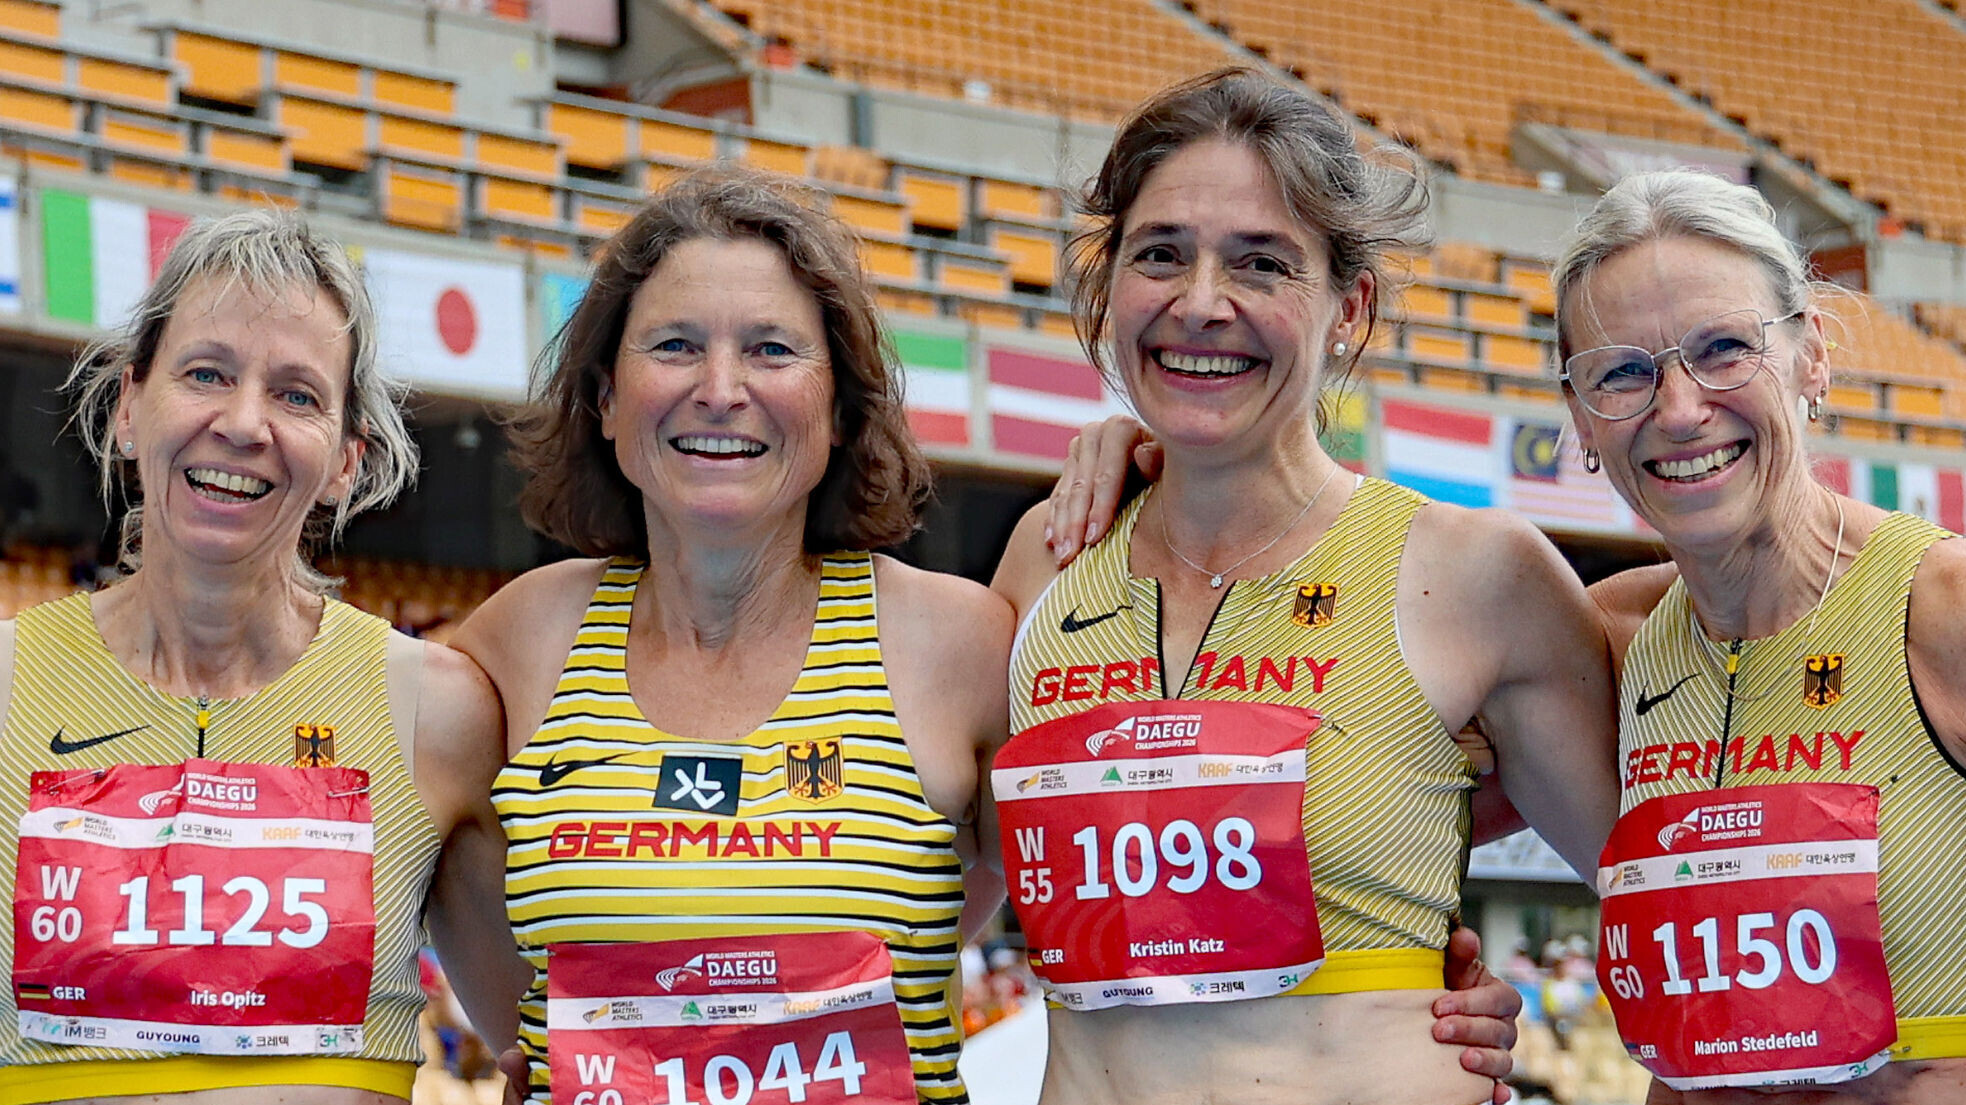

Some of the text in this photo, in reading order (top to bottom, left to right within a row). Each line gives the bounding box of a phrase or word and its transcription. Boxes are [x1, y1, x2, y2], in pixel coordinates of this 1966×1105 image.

[1031, 651, 1340, 707] GERMANY
[1136, 722, 1201, 741] DAEGU
[1625, 731, 1865, 789] GERMANY
[188, 780, 257, 802] DAEGU
[1701, 810, 1762, 831] DAEGU
[547, 822, 843, 859] GERMANY
[1015, 826, 1045, 862] W
[1073, 816, 1263, 901] 1098
[41, 865, 83, 901] W
[1019, 869, 1054, 905] 55
[31, 906, 83, 943] 60
[112, 874, 330, 949] 1125
[1041, 948, 1064, 964] GER
[1129, 938, 1225, 958] Kristin Katz
[1605, 924, 1629, 961] W
[1652, 908, 1837, 996] 1150
[707, 959, 777, 977] DAEGU
[1610, 965, 1645, 1000] 60
[53, 986, 86, 1001] GER
[190, 991, 266, 1009] Iris Opitz
[136, 1030, 200, 1043] GUYOUNG
[1640, 1044, 1658, 1059] GER
[1694, 1030, 1818, 1056] Marion Stedefeld
[574, 1053, 617, 1086] W
[654, 1031, 867, 1105] 1044
